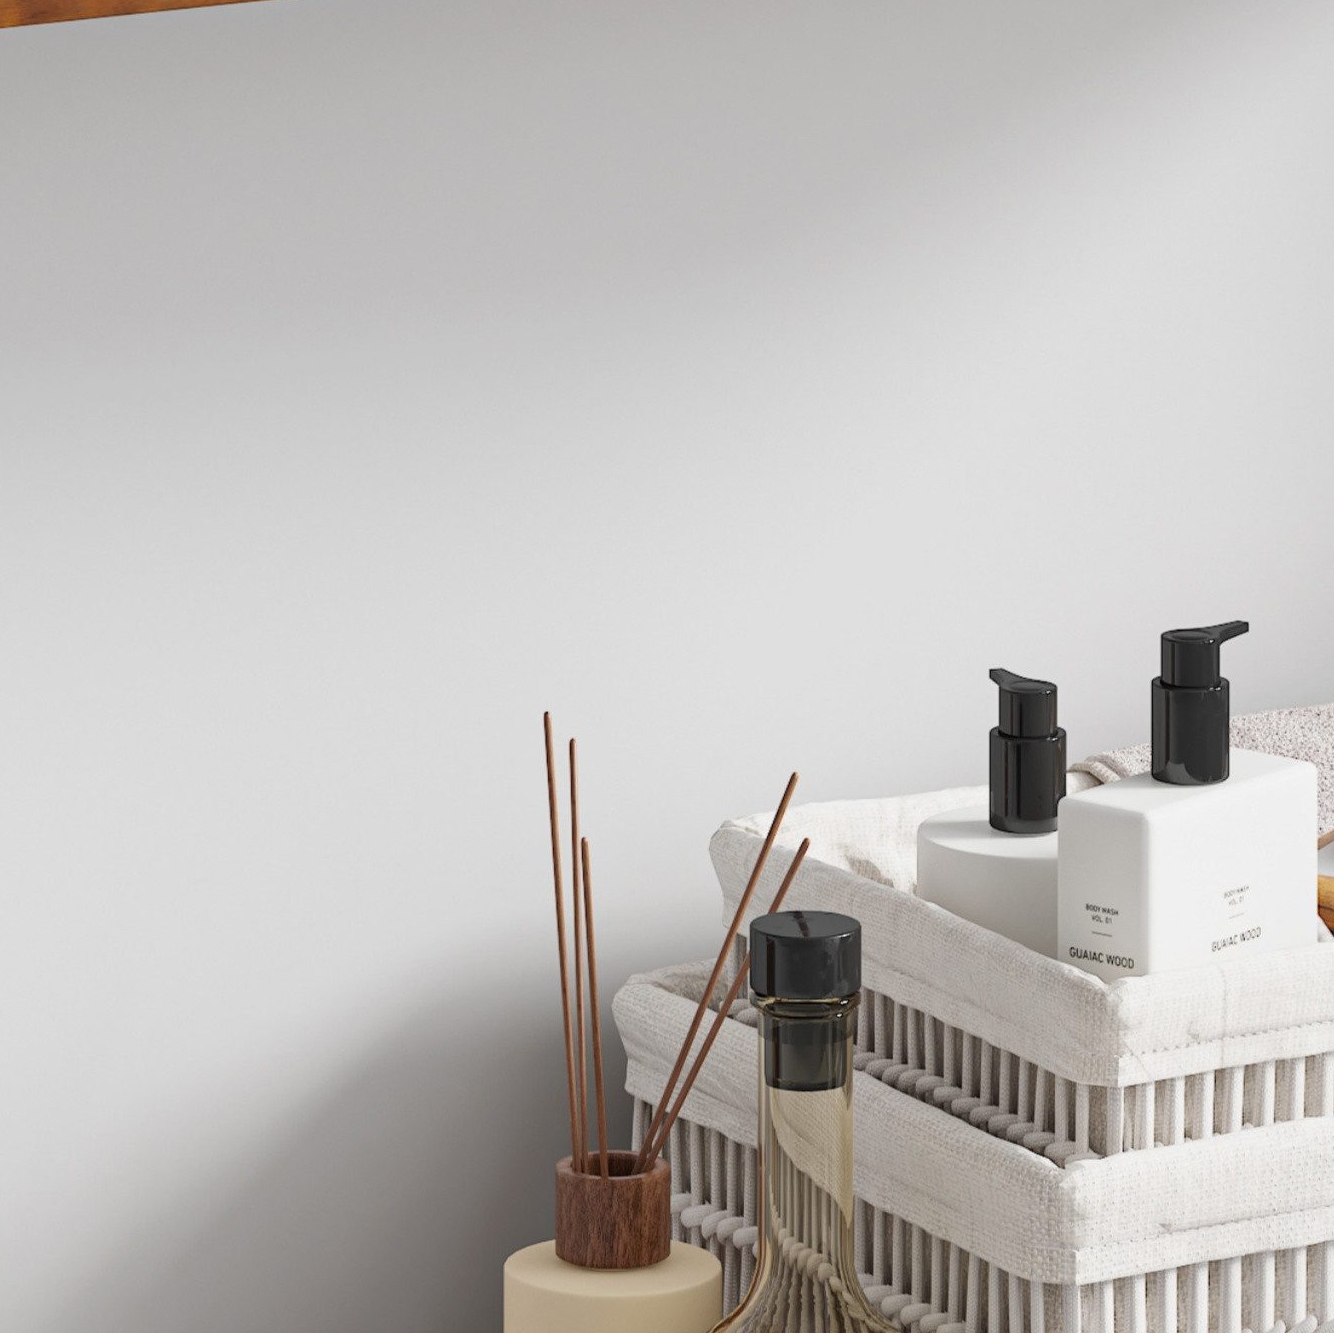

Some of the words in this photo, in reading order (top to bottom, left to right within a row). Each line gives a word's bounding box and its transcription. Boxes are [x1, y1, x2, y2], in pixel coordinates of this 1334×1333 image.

[1085, 903, 1101, 913] BODY
[1101, 906, 1119, 916] WASH
[1211, 934, 1239, 953] GUAIAC
[1239, 926, 1262, 942] WOOD
[1069, 946, 1104, 964] GUAIAC
[1105, 953, 1135, 970] WOOD
